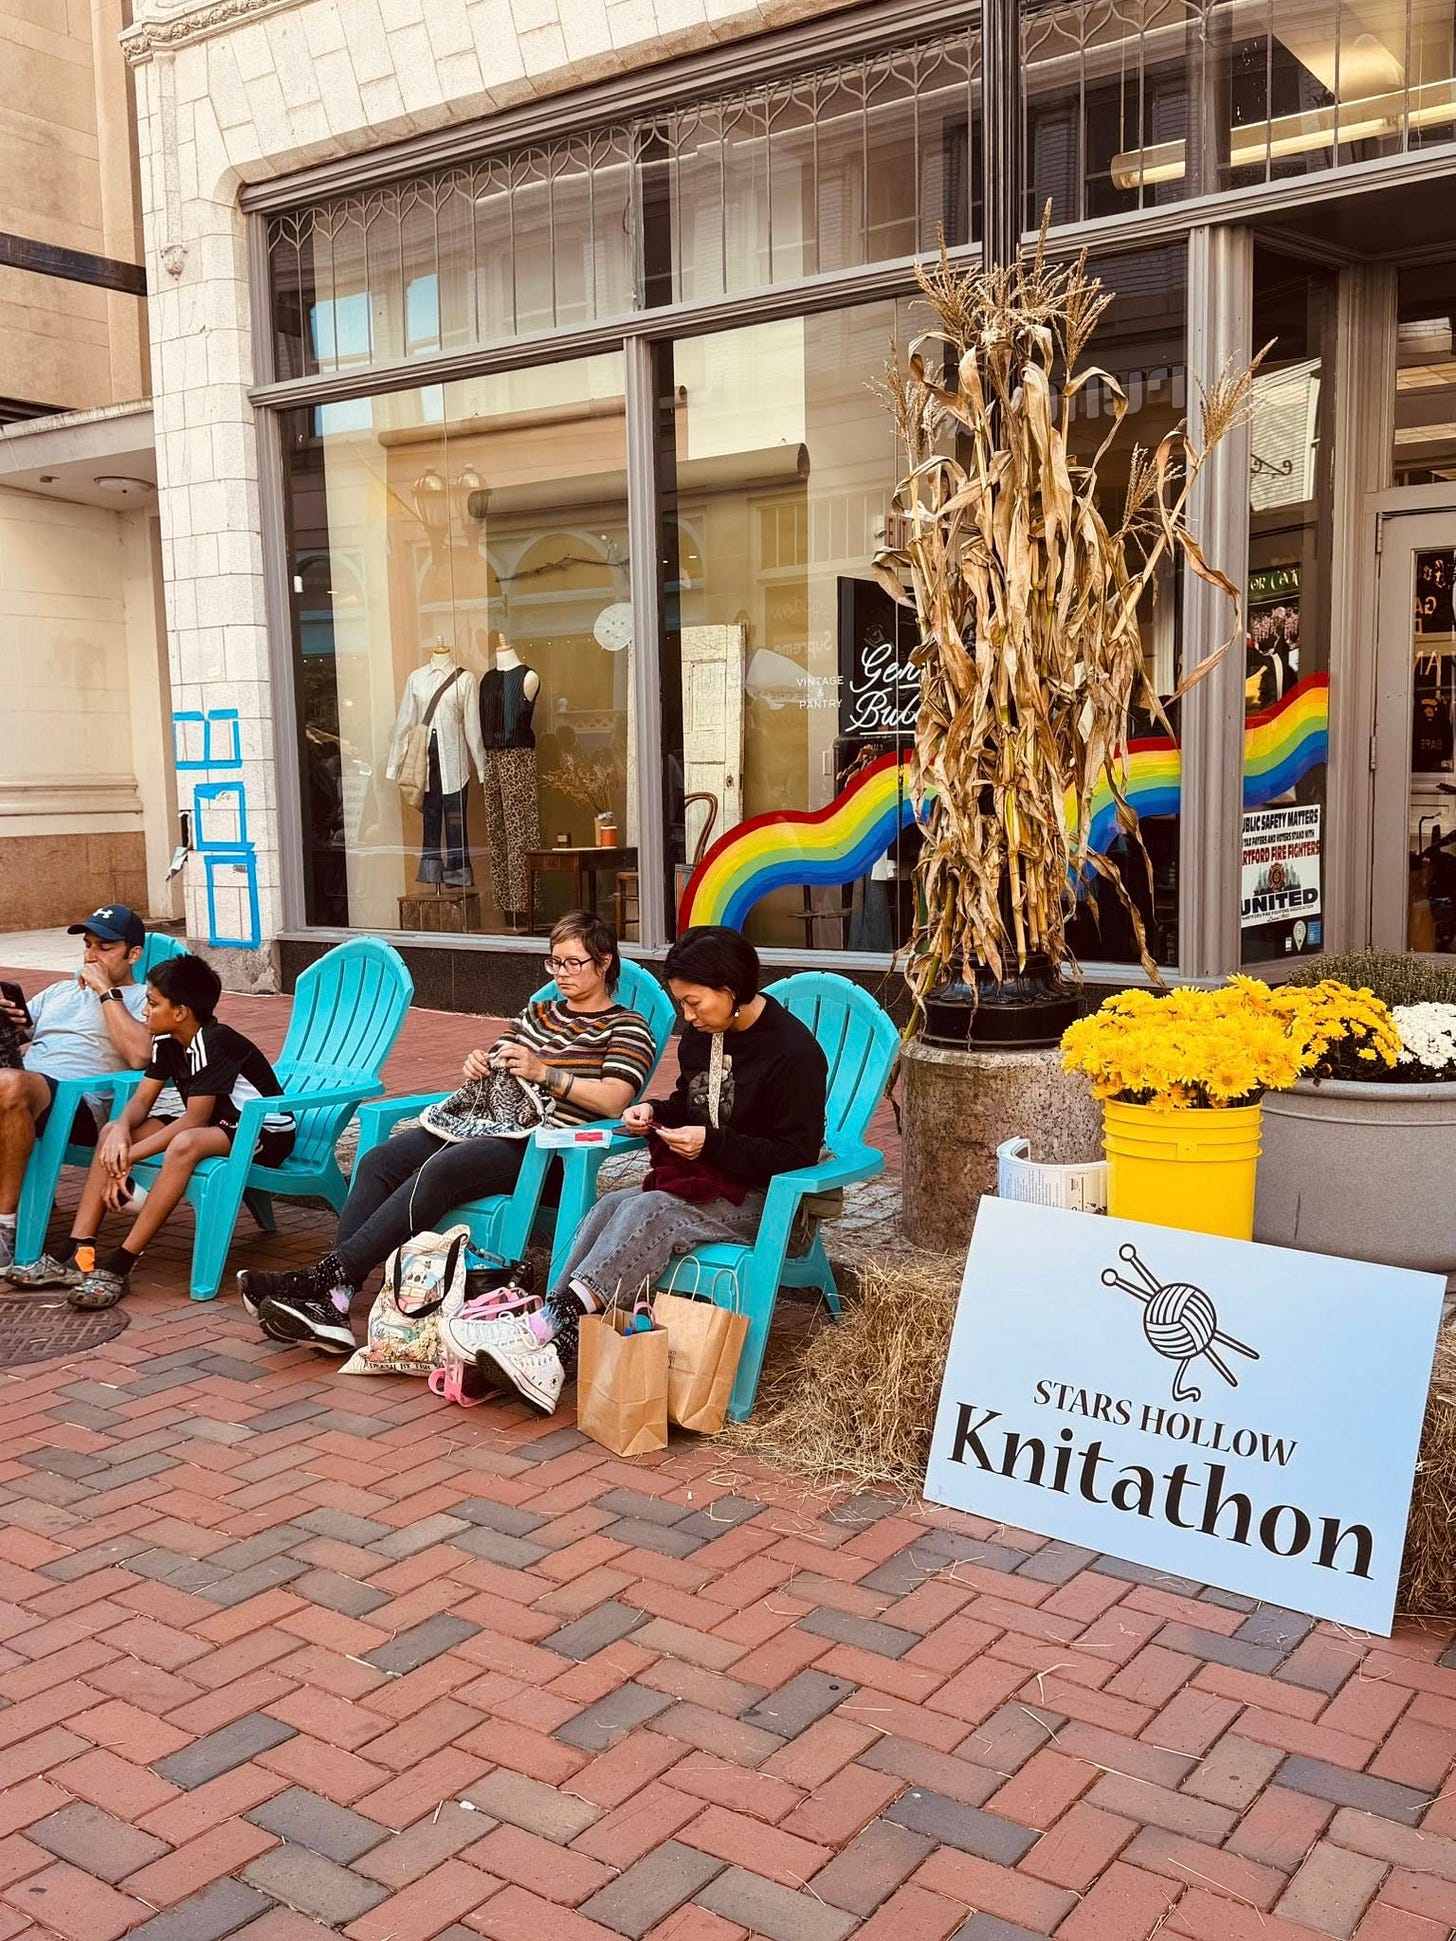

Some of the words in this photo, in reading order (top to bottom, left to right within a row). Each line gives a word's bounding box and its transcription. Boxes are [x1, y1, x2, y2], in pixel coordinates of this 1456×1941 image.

[796, 676, 845, 687] VINTAGE
[817, 688, 824, 697] &
[799, 699, 843, 710] PANTRY
[1261, 812, 1287, 830] SAFETY
[1287, 808, 1318, 827] MATTERS
[1242, 847, 1270, 866] RTFORD
[1271, 845, 1287, 861] FIRE
[1287, 840, 1320, 859] FIGHTERS
[1241, 888, 1318, 916] UNITED
[1034, 1379, 1132, 1425] STARS
[1139, 1404, 1298, 1466] HOLLOW
[947, 1402, 1374, 1580] Knitathon
